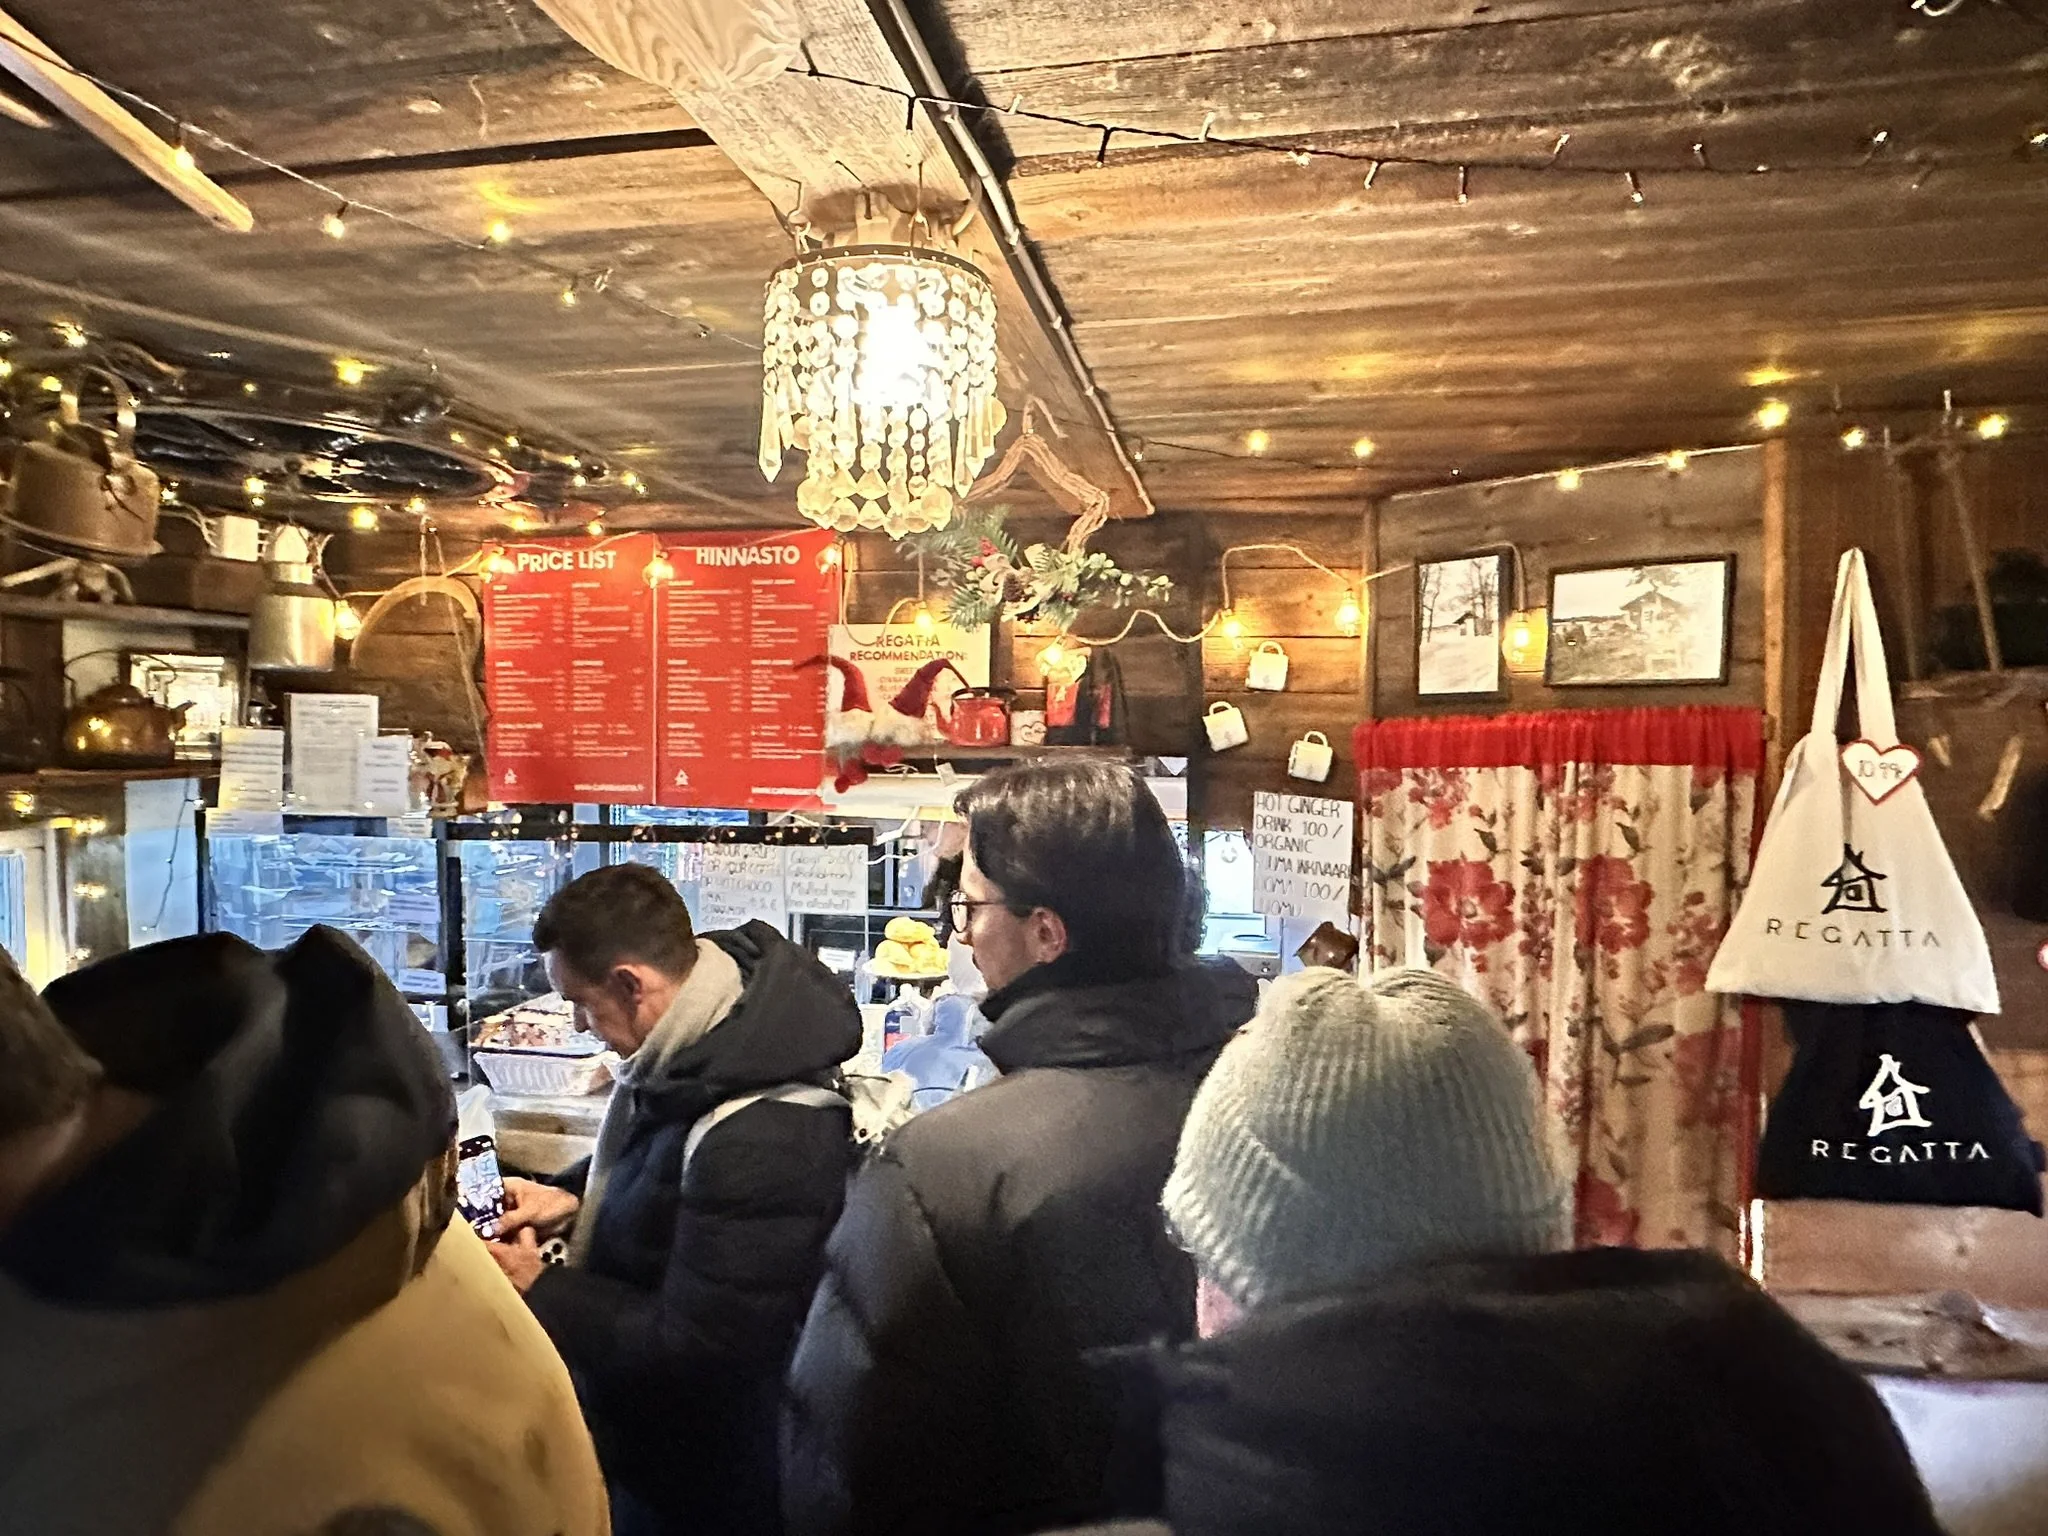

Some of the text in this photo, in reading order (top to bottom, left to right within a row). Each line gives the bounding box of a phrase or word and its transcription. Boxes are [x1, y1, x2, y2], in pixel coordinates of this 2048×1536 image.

[517, 551, 616, 573] PRICE LIST
[696, 545, 800, 567] HINNASTO
[875, 634, 941, 648] REGATTA
[1288, 795, 1341, 819] GINGER
[1255, 814, 1292, 833] DRINK
[1255, 833, 1313, 854] ORGANIC
[1766, 918, 1941, 948] REGATTA
[1811, 1138, 1991, 1164] REGATTA
